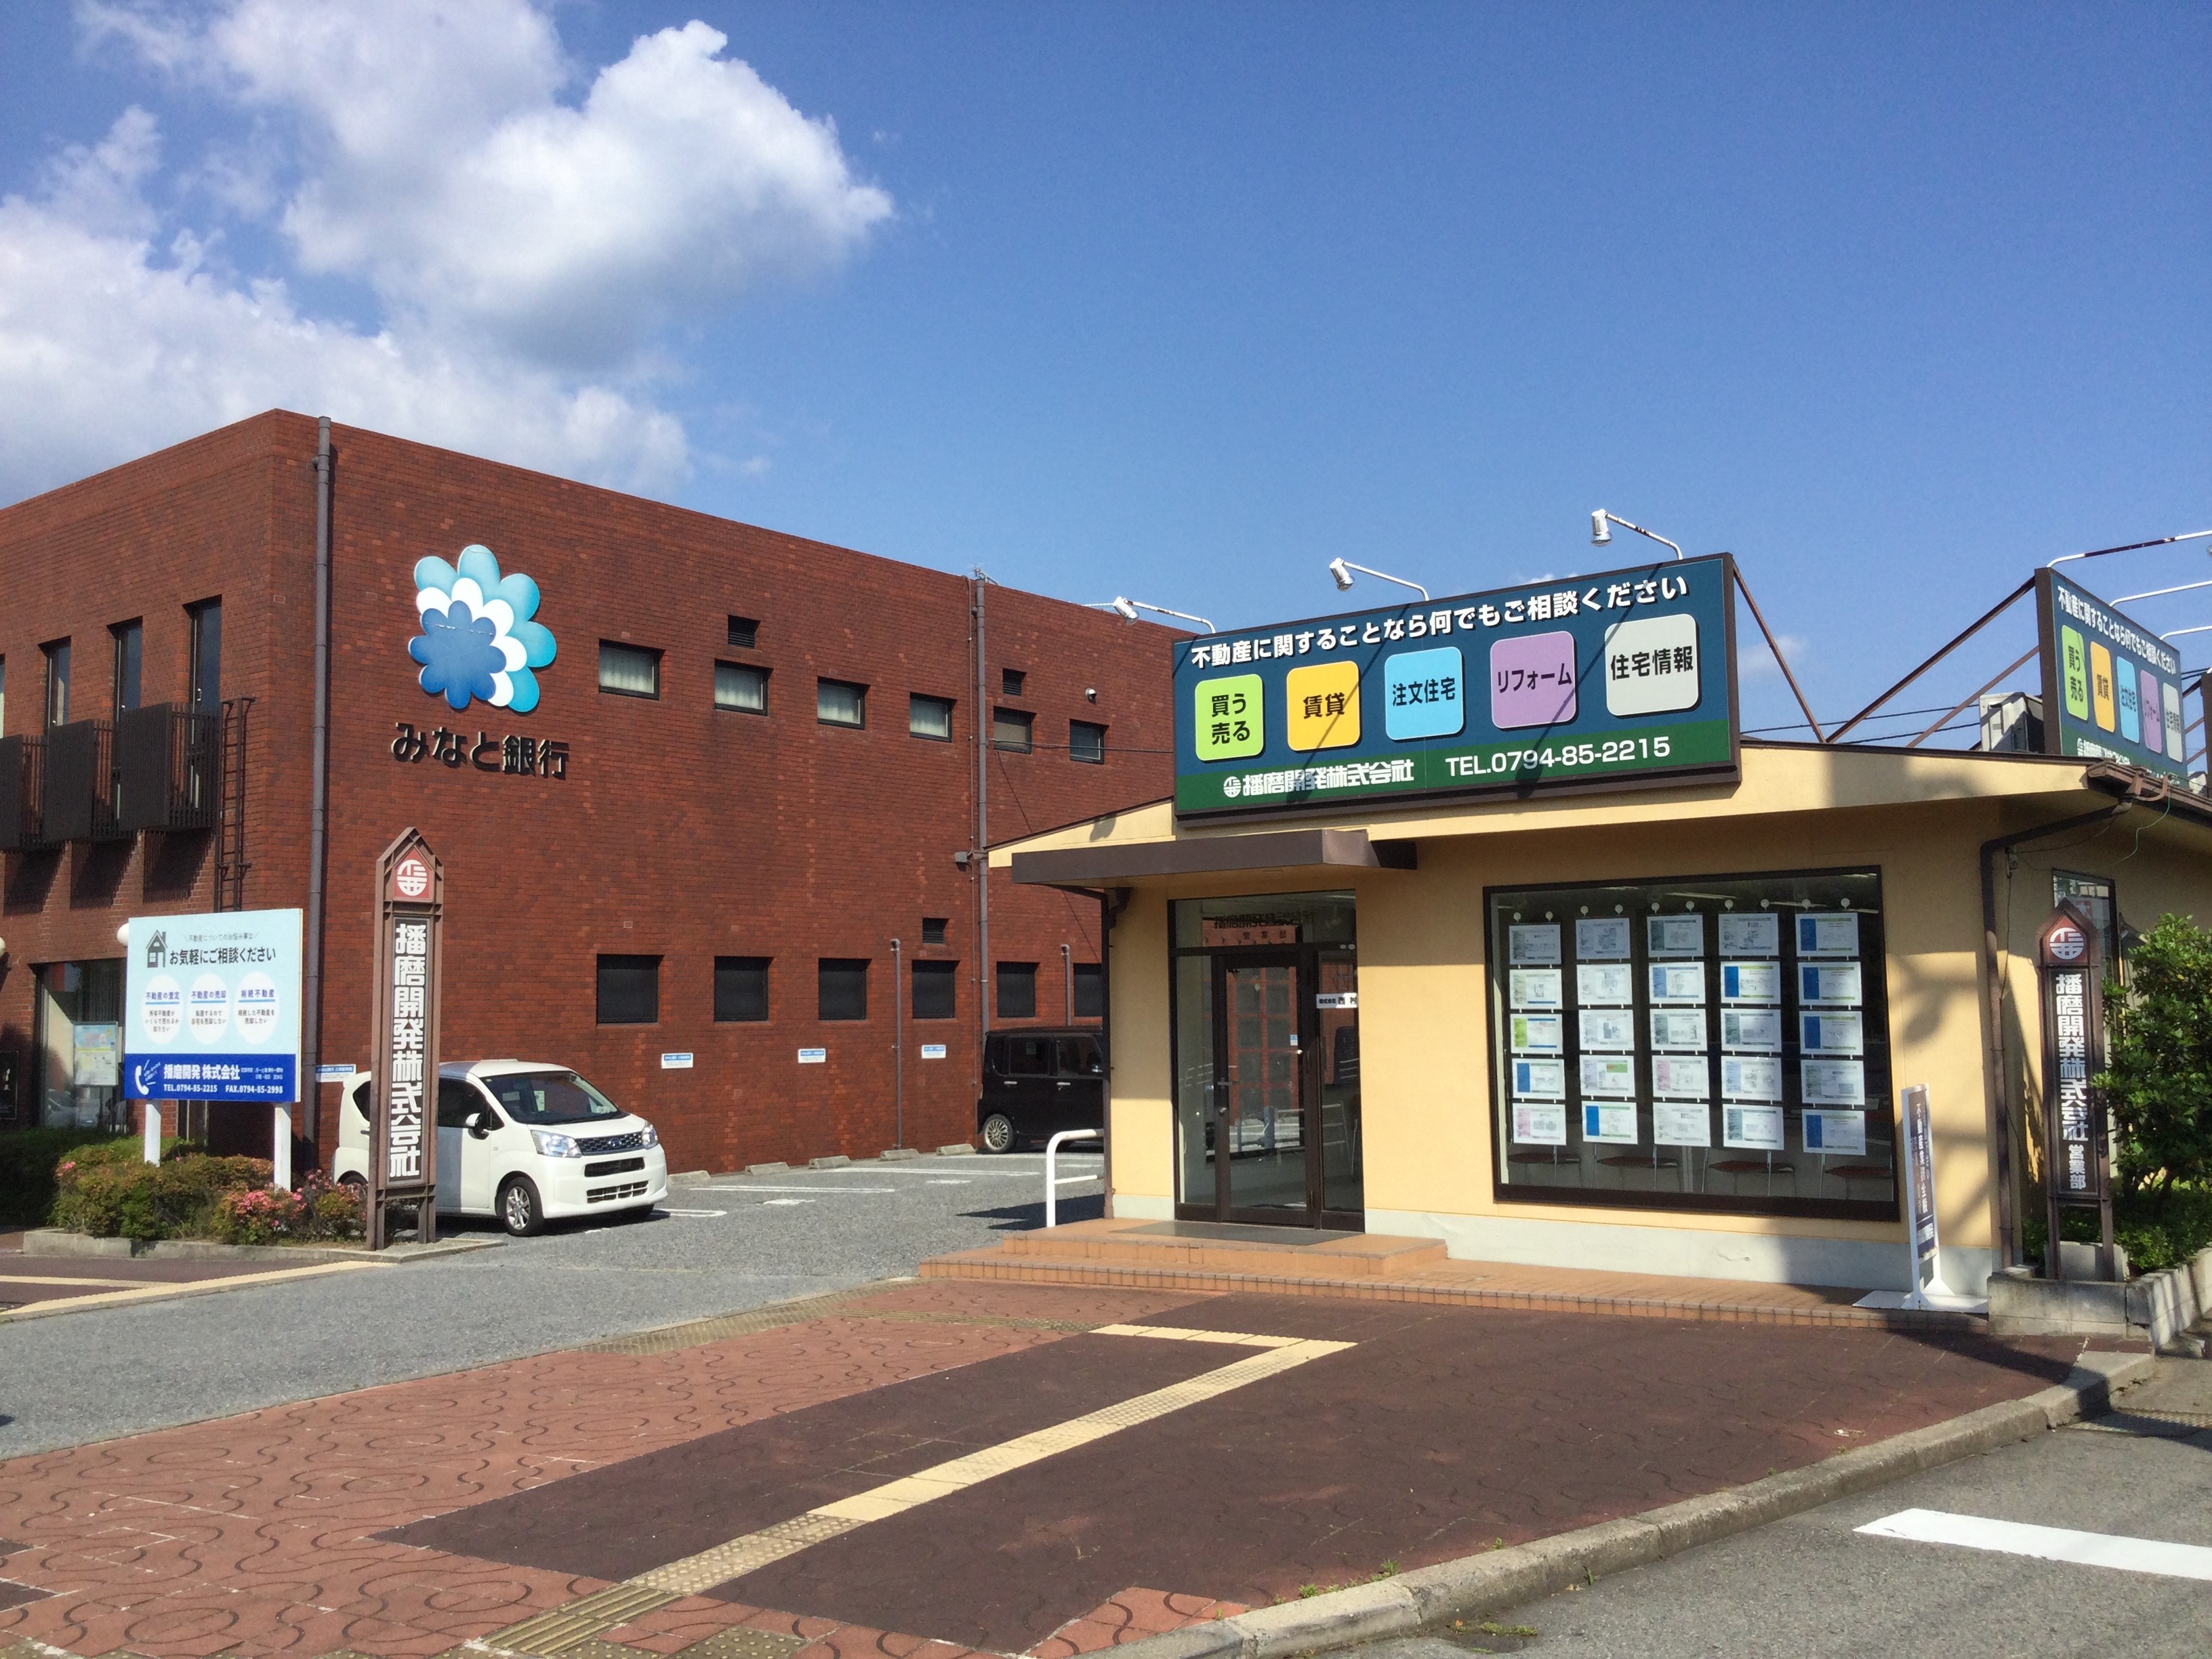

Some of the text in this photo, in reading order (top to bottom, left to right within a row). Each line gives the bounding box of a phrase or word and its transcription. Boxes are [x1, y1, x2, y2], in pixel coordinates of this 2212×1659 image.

[1191, 576, 1689, 669] 不動産に関することなら何でもご相談ください
[1497, 663, 1573, 694] リフォーム
[1610, 646, 1694, 682] 住宅情報
[1211, 693, 1248, 716] 買う
[1303, 693, 1345, 718] 賃貸
[1391, 677, 1456, 708] 注文住宅
[1211, 720, 1250, 745] 売る
[391, 722, 569, 779] みなと銀行
[1446, 736, 1671, 778] TEL.0794-85-2215
[1243, 759, 1414, 796] 播磨開発株式会社
[169, 946, 276, 966] お気軽にご相談ください
[390, 924, 426, 1179] 播磨開発株式会社
[2055, 973, 2089, 1142] 播磨開発株式会社
[163, 1064, 201, 1080] 播磨開発
[202, 1064, 241, 1080] 株式会社
[163, 1084, 283, 1094] TEL.0794-85-2215 FAX.0794-85-2998
[2068, 1144, 2087, 1190] 営業部
